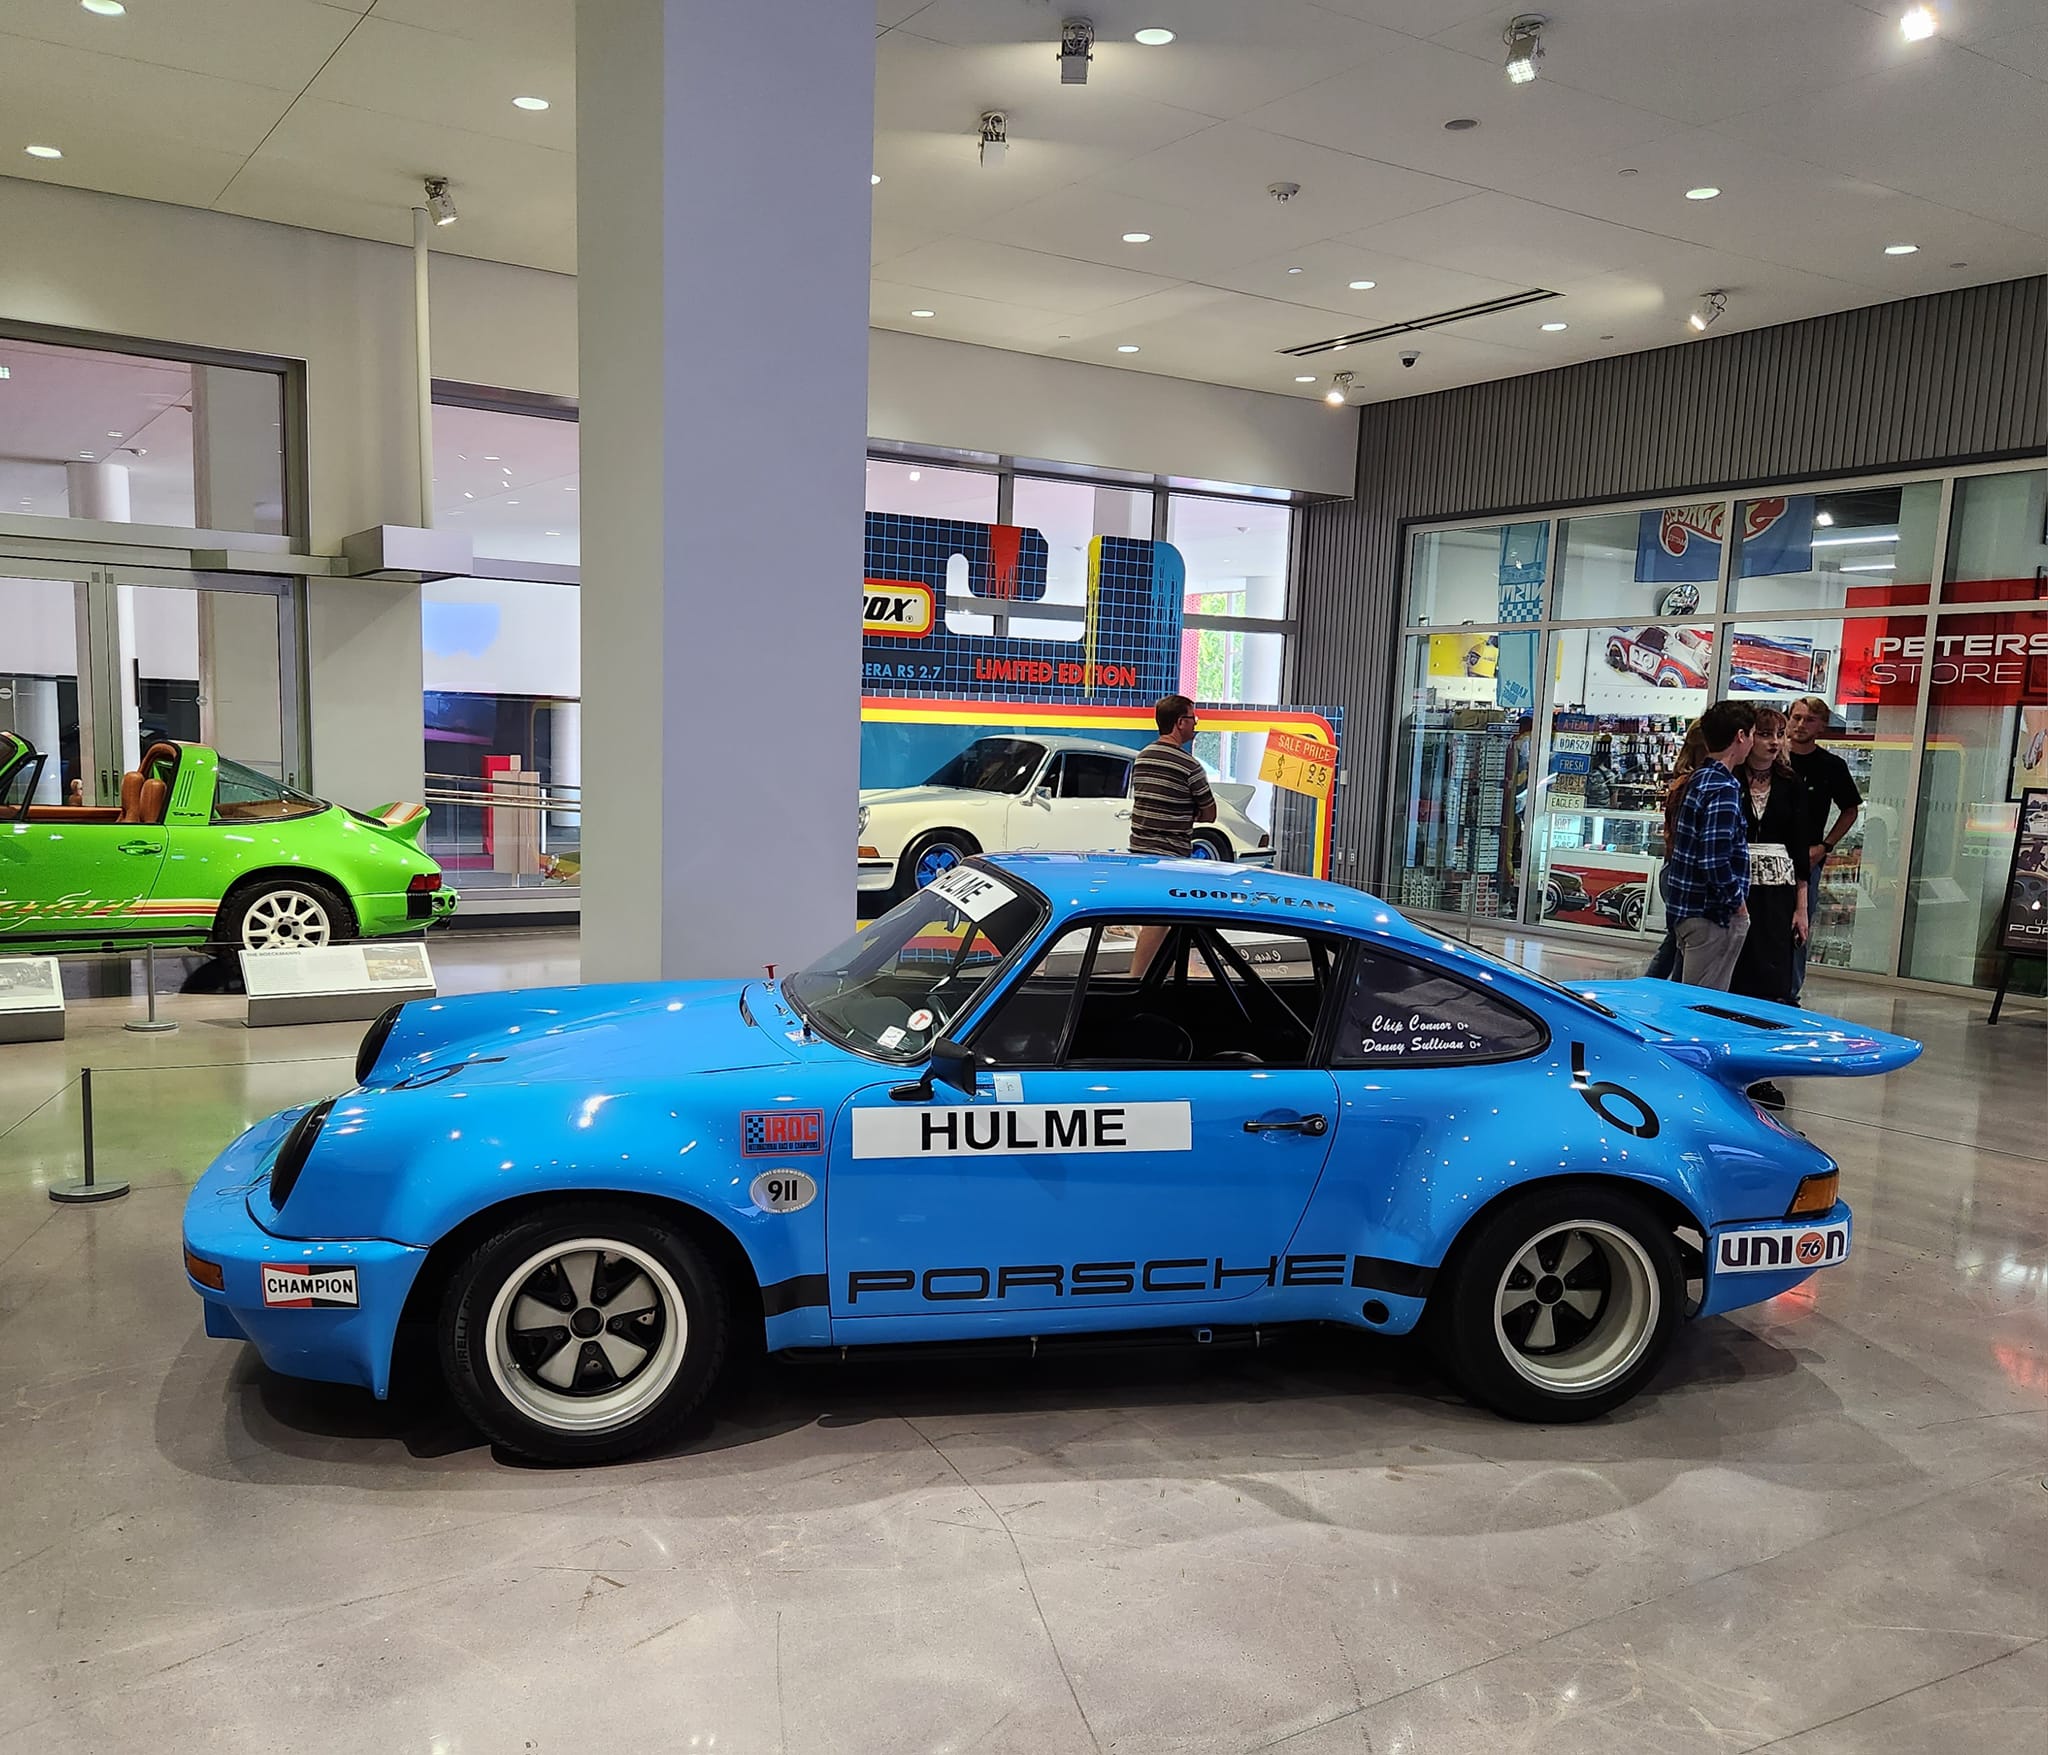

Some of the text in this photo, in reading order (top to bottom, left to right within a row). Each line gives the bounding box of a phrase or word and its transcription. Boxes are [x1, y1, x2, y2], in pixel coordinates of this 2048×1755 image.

[897, 664, 914, 678] RS
[920, 666, 941, 679] 2.7
[976, 658, 1053, 683] LIMITED
[1871, 663, 2023, 684] STORE
[1278, 735, 1330, 761] SALE PRICE
[1560, 758, 1584, 771] FRESH
[1168, 888, 1337, 913] GOODYEAR
[1371, 1015, 1404, 1034] Chip
[1409, 1014, 1453, 1032] Connor
[1362, 1038, 1405, 1055] Danny
[1411, 1037, 1465, 1051] Sullivan
[765, 1116, 818, 1143] IROC
[920, 1108, 1128, 1151] HULME
[767, 1179, 798, 1202] 911
[267, 1278, 353, 1293] CHAMPION
[847, 1254, 1347, 1304] PORSCHE
